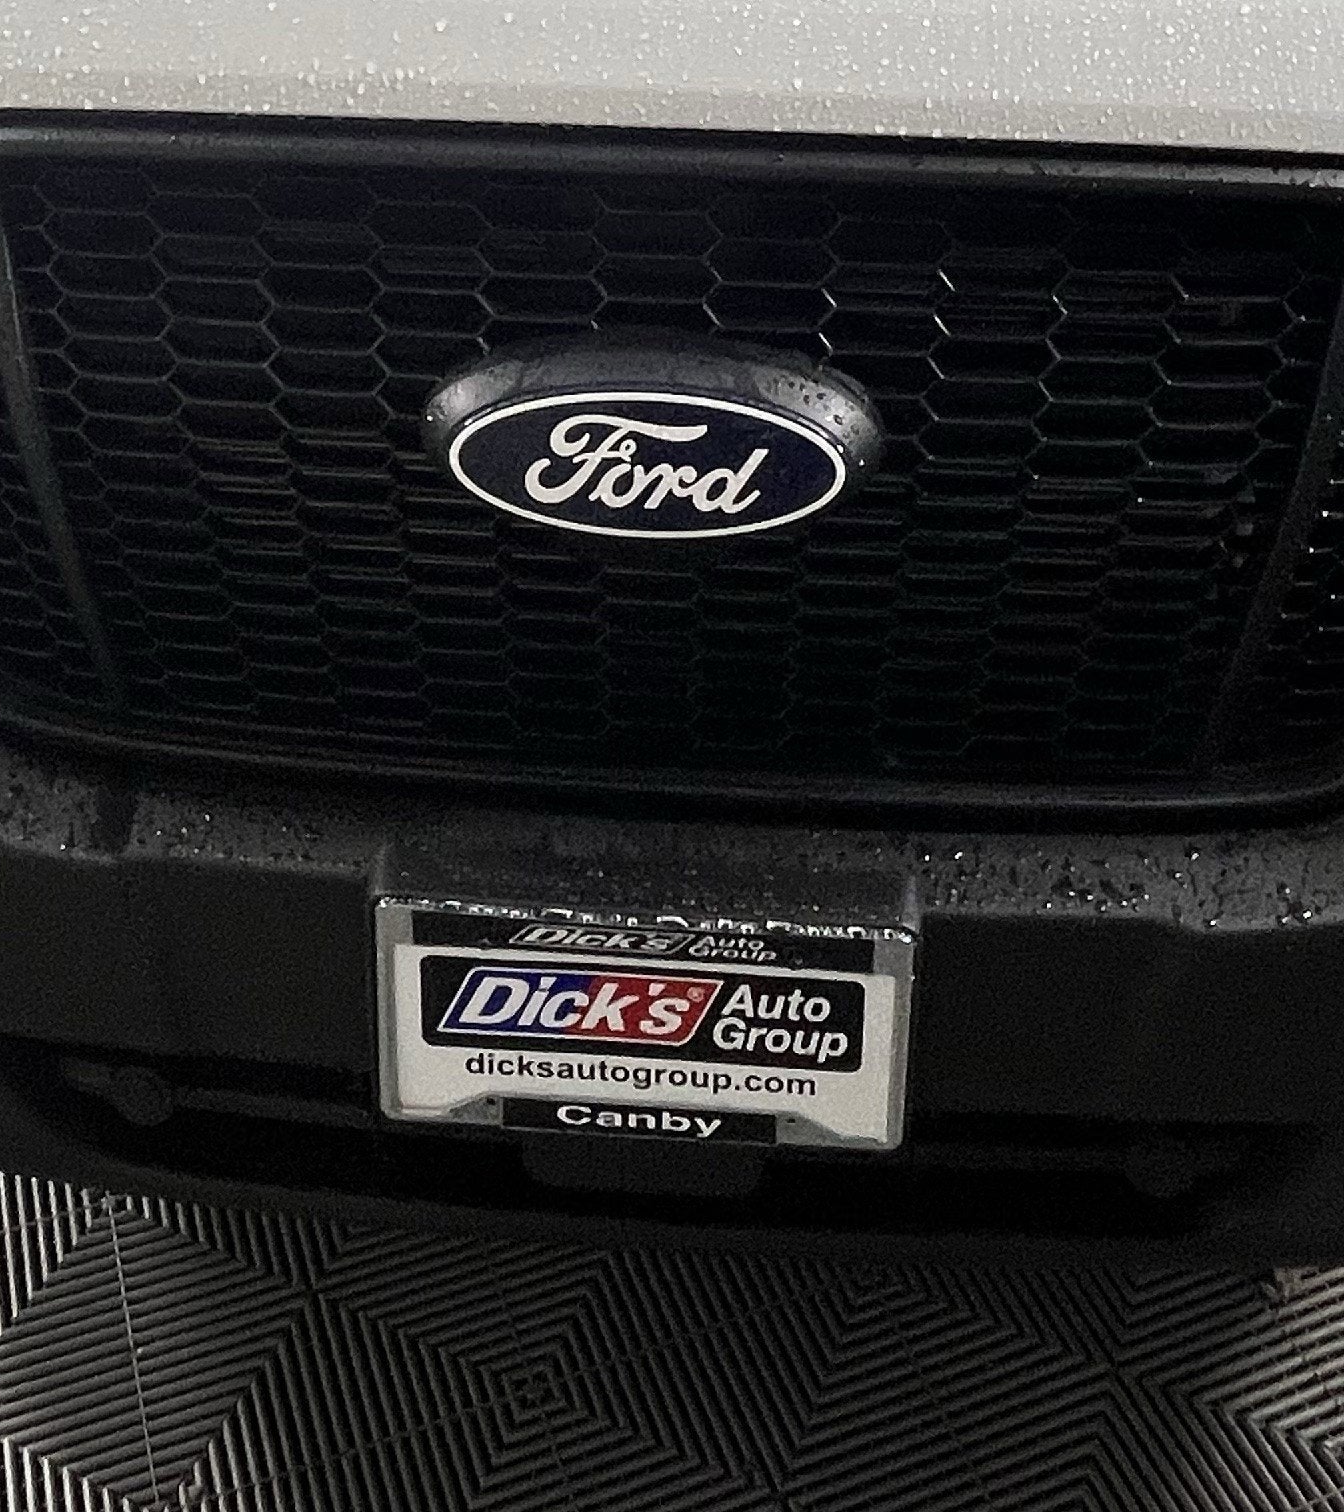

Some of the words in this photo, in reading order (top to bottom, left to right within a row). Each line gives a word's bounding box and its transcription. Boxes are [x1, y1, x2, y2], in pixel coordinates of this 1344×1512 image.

[524, 414, 769, 514] Ford
[458, 976, 691, 1036] Dick's
[721, 984, 831, 1022] Auto
[712, 1016, 848, 1063] Group
[464, 1052, 817, 1096] dicksautogroup.com
[556, 1105, 722, 1138] Canby
